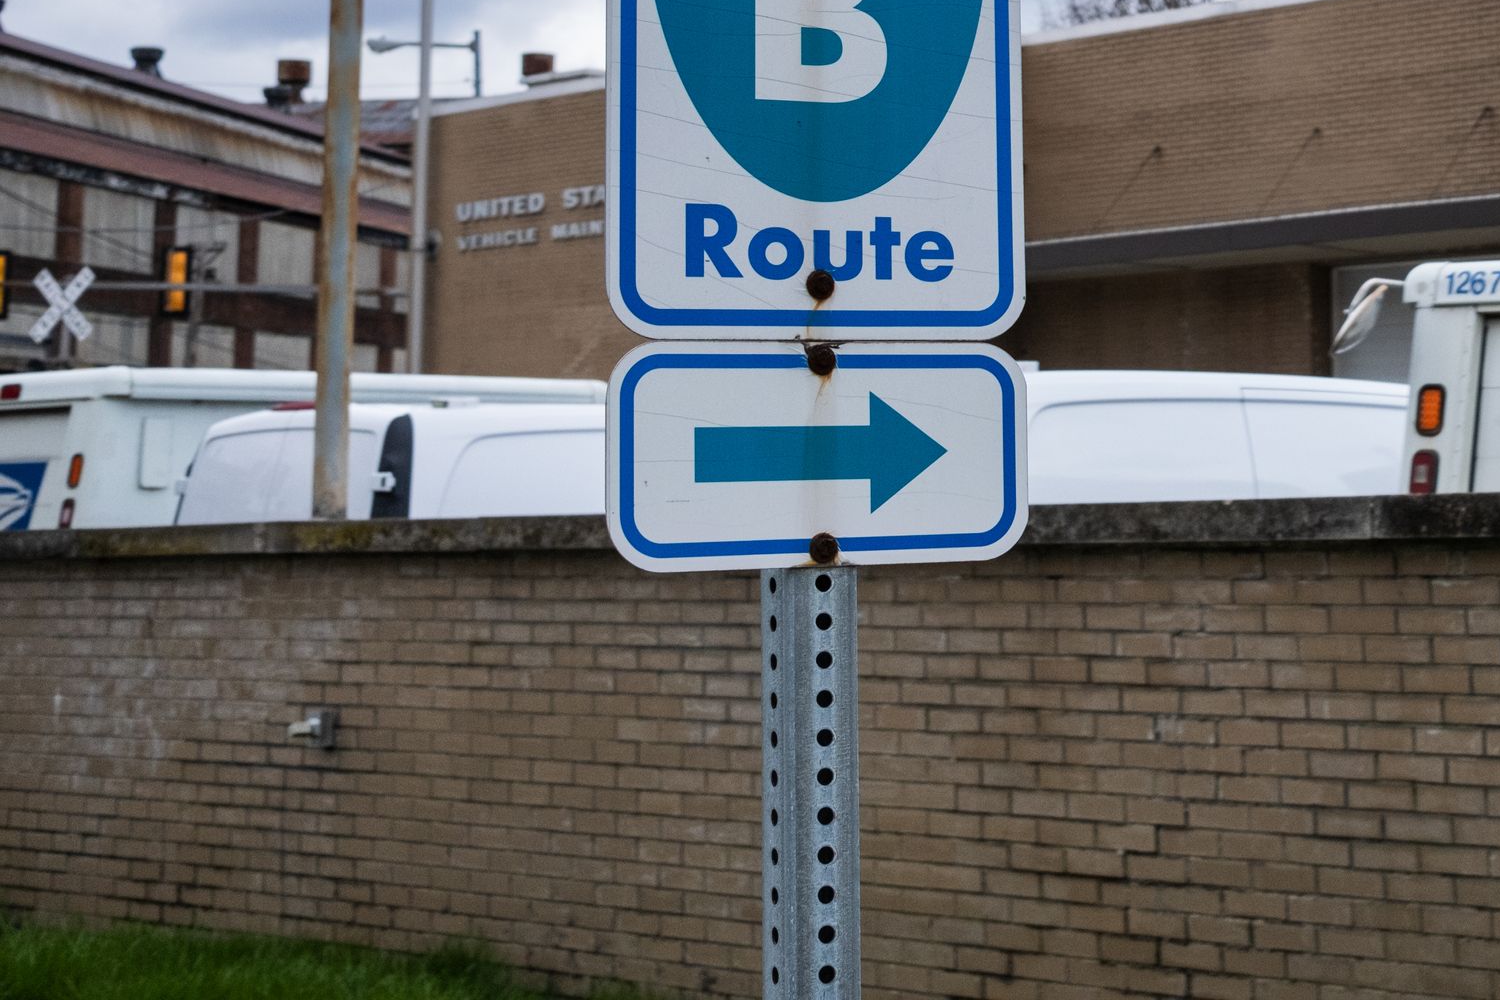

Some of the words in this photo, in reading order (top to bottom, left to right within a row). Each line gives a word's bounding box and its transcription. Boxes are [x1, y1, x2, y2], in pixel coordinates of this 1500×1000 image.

[456, 192, 546, 222] UNITED
[457, 227, 538, 250] VEHICLE
[684, 202, 956, 284] Route
